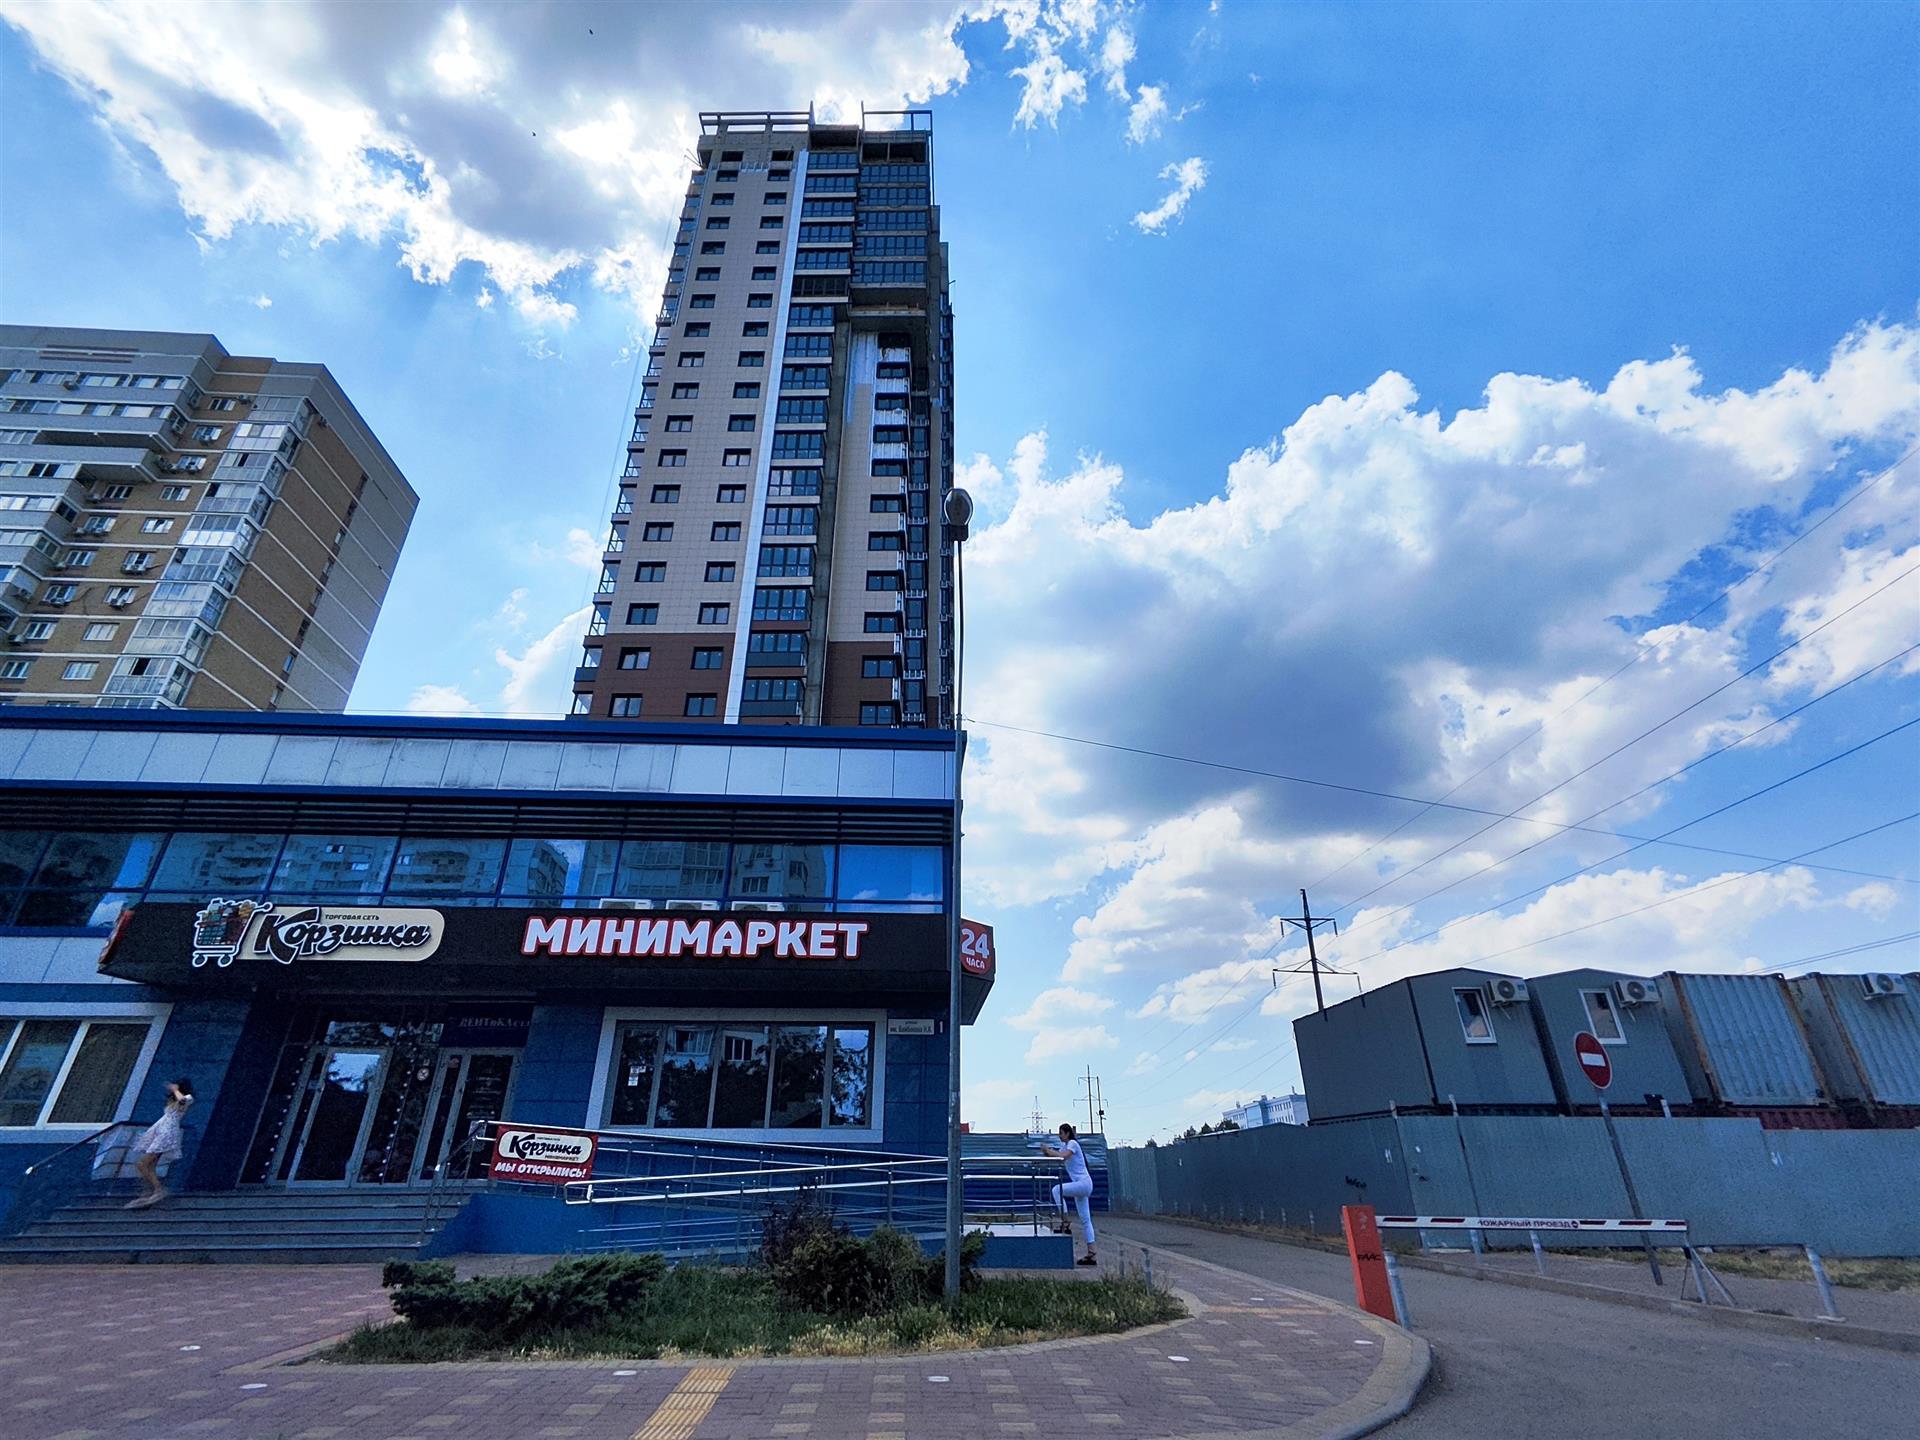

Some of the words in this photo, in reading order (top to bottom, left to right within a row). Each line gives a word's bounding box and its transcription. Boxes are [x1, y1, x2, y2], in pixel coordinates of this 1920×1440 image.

[324, 913, 362, 921] ТОРГОВАЯ
[253, 906, 431, 965] Корзинка
[523, 918, 868, 957] МИНИМАРКЕТ
[961, 928, 990, 959] 24
[966, 957, 985, 969] ЧАСА
[508, 1133, 582, 1160] Корзинка
[495, 1162, 517, 1172] МЫ
[517, 1163, 587, 1178] ОТКРЫЛИСЬ!
